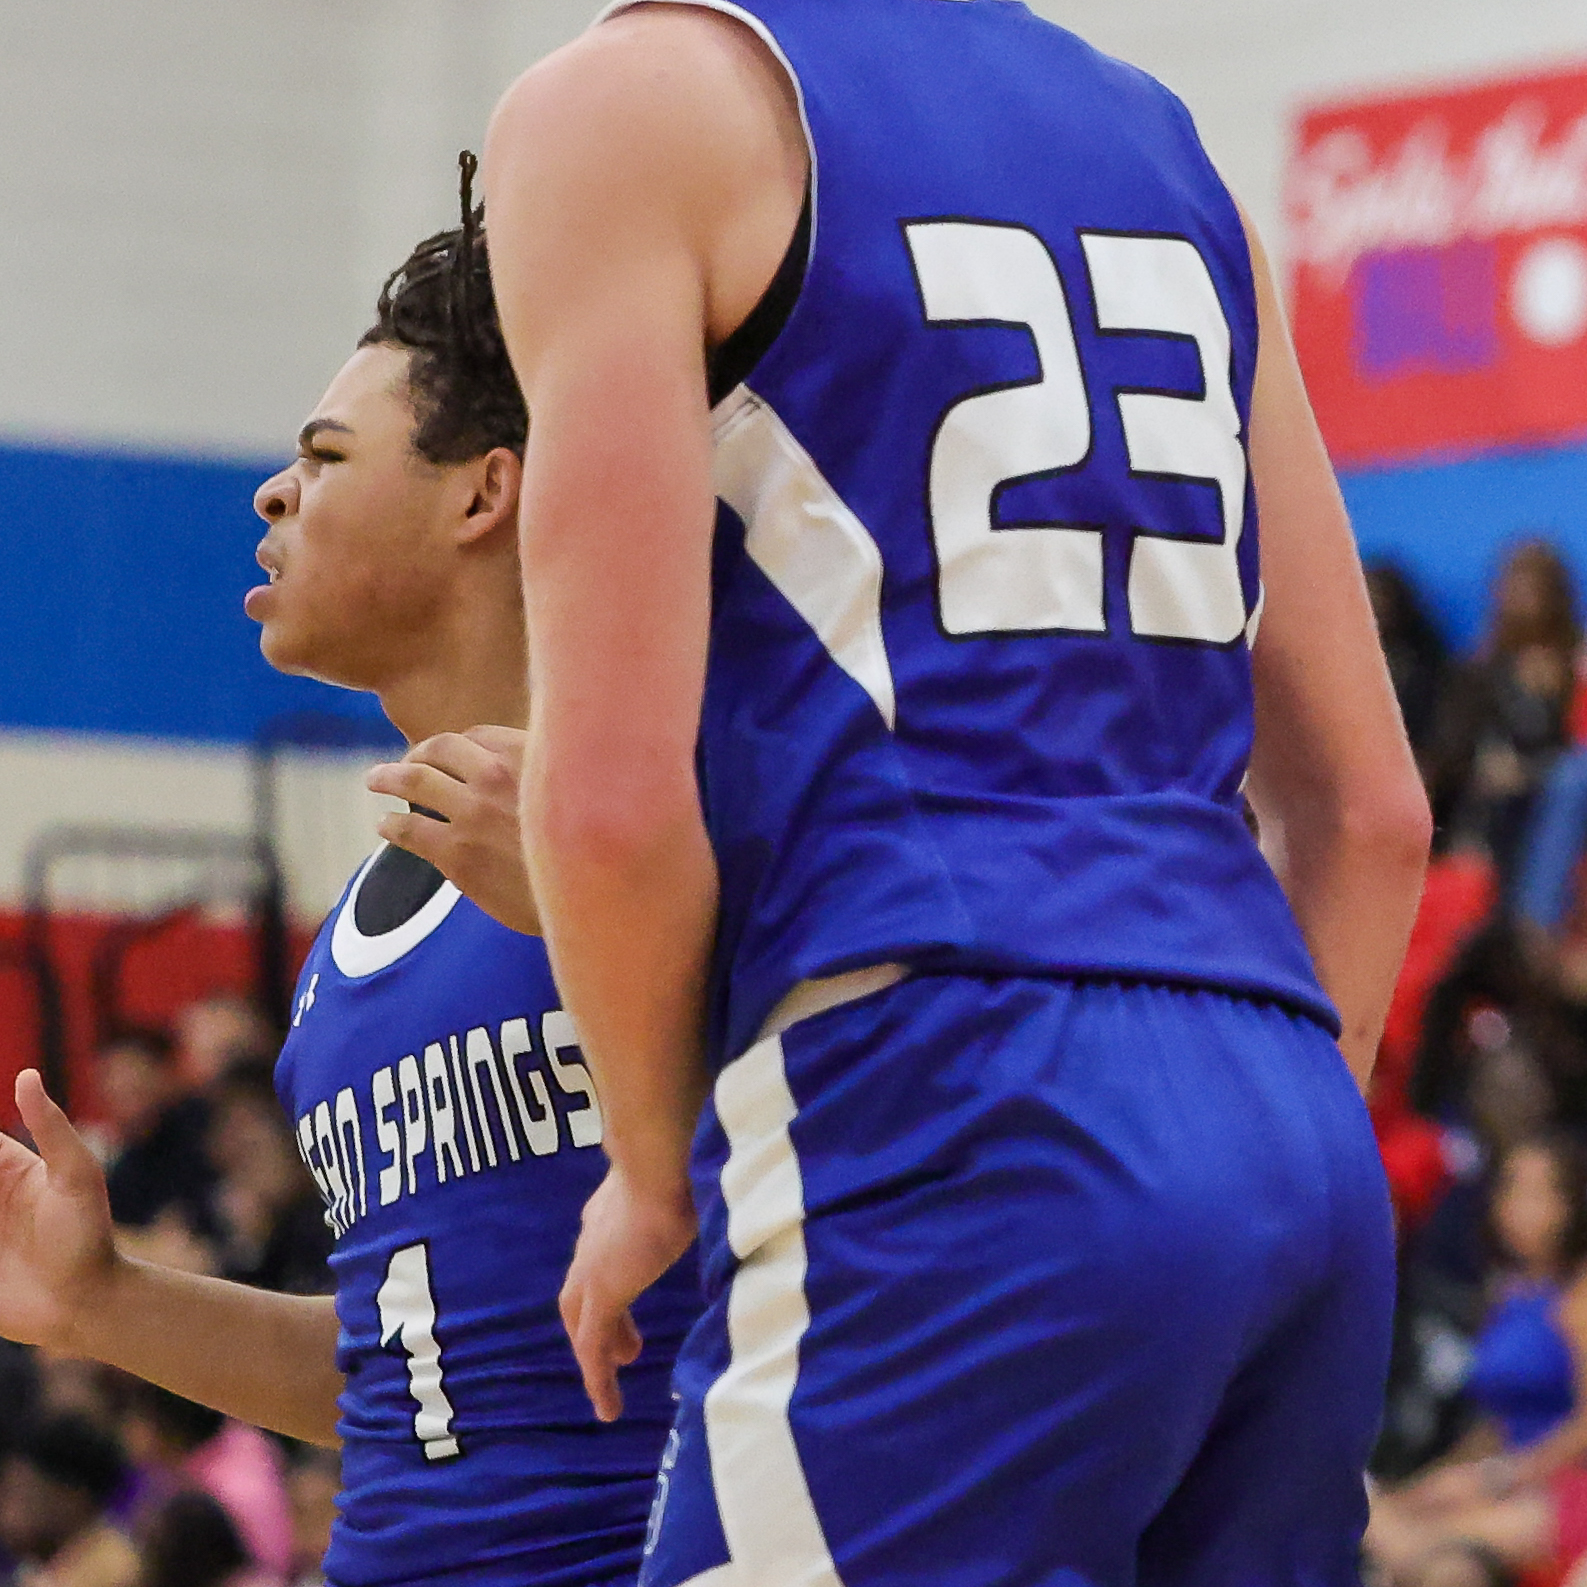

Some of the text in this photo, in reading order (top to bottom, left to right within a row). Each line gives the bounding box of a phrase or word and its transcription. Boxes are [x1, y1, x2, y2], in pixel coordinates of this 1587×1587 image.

[901, 217, 1247, 651] 23
[372, 1010, 603, 1206] SPRINGS
[376, 1241, 464, 1463] 1
